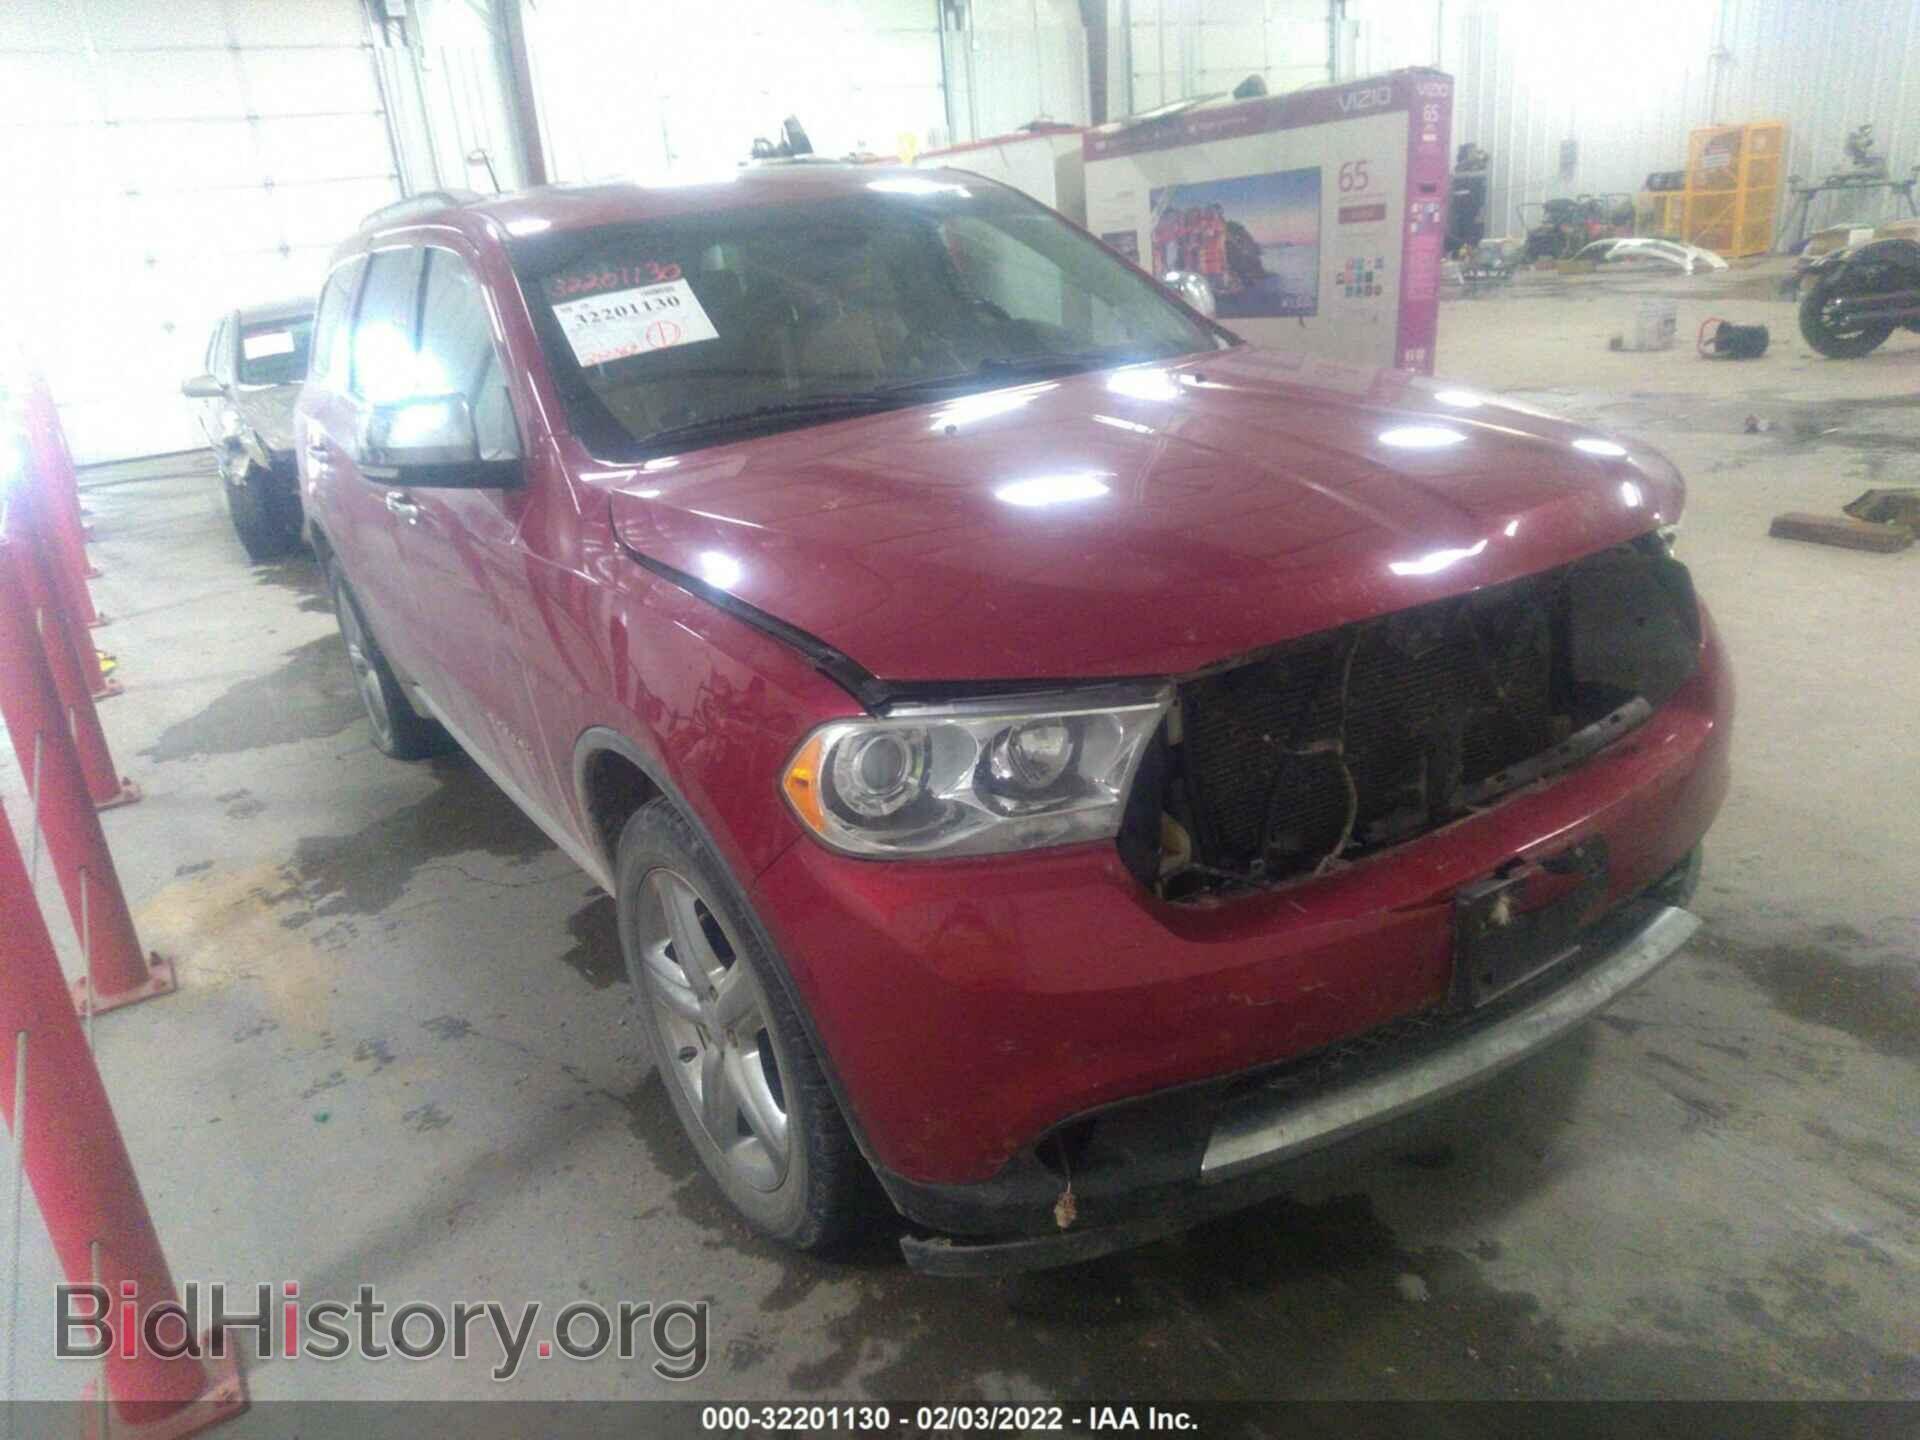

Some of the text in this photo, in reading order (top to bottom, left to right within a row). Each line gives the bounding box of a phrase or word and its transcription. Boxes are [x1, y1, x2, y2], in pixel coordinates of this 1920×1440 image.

[1338, 86, 1392, 113] VIZIO
[1423, 103, 1440, 123] 65
[1338, 160, 1369, 192] 65
[576, 296, 681, 328] 32201130
